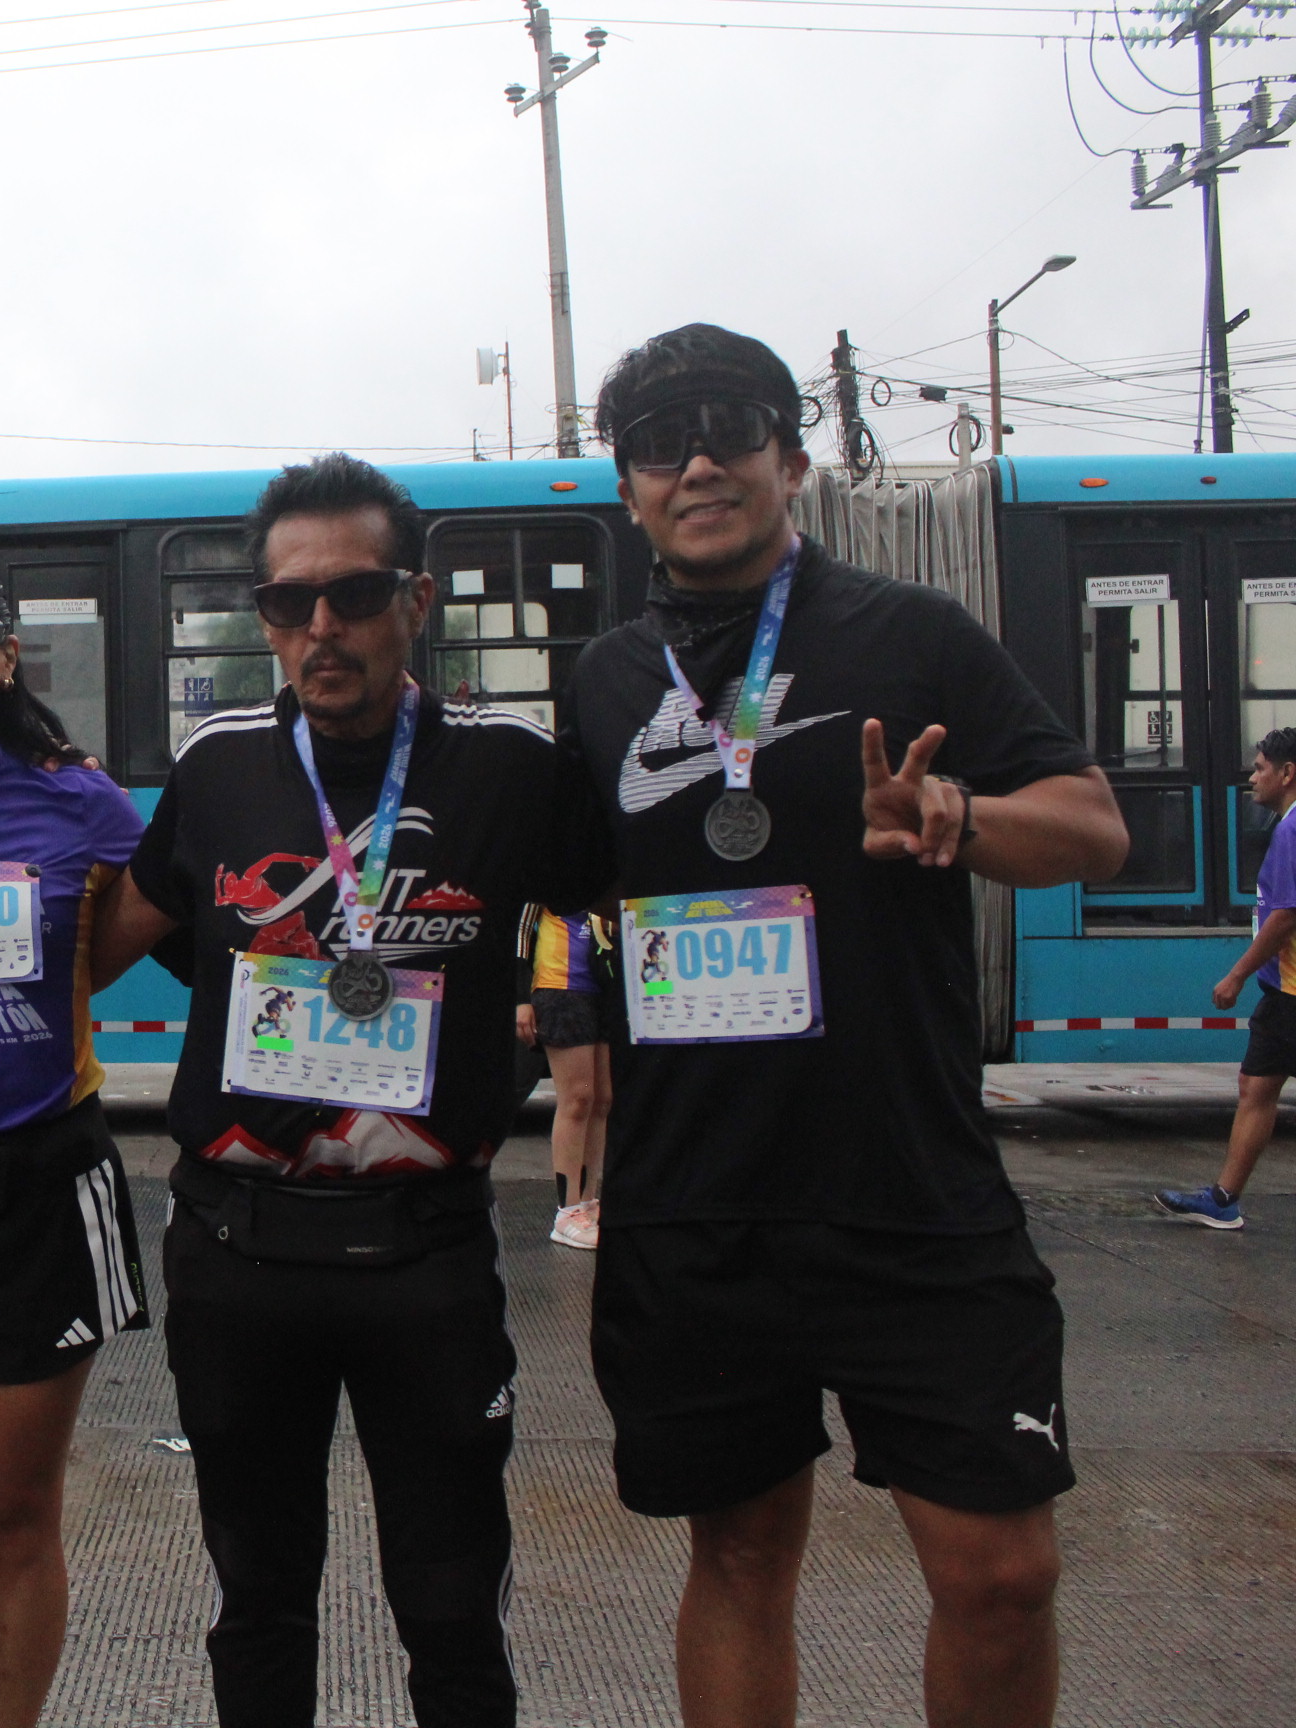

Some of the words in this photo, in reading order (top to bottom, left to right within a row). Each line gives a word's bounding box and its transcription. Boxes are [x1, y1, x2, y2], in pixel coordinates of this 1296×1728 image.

[1091, 580, 1117, 588] ANTES
[1131, 579, 1164, 587] ENTRAR
[1098, 588, 1133, 596] PERMITA
[1134, 587, 1158, 595] SALIR
[756, 655, 770, 681] 2026
[378, 823, 393, 849] 2026
[675, 923, 793, 980] 0947
[268, 967, 289, 976] 2026
[302, 995, 418, 1052] 1248
[23, 1031, 53, 1042] 2026
